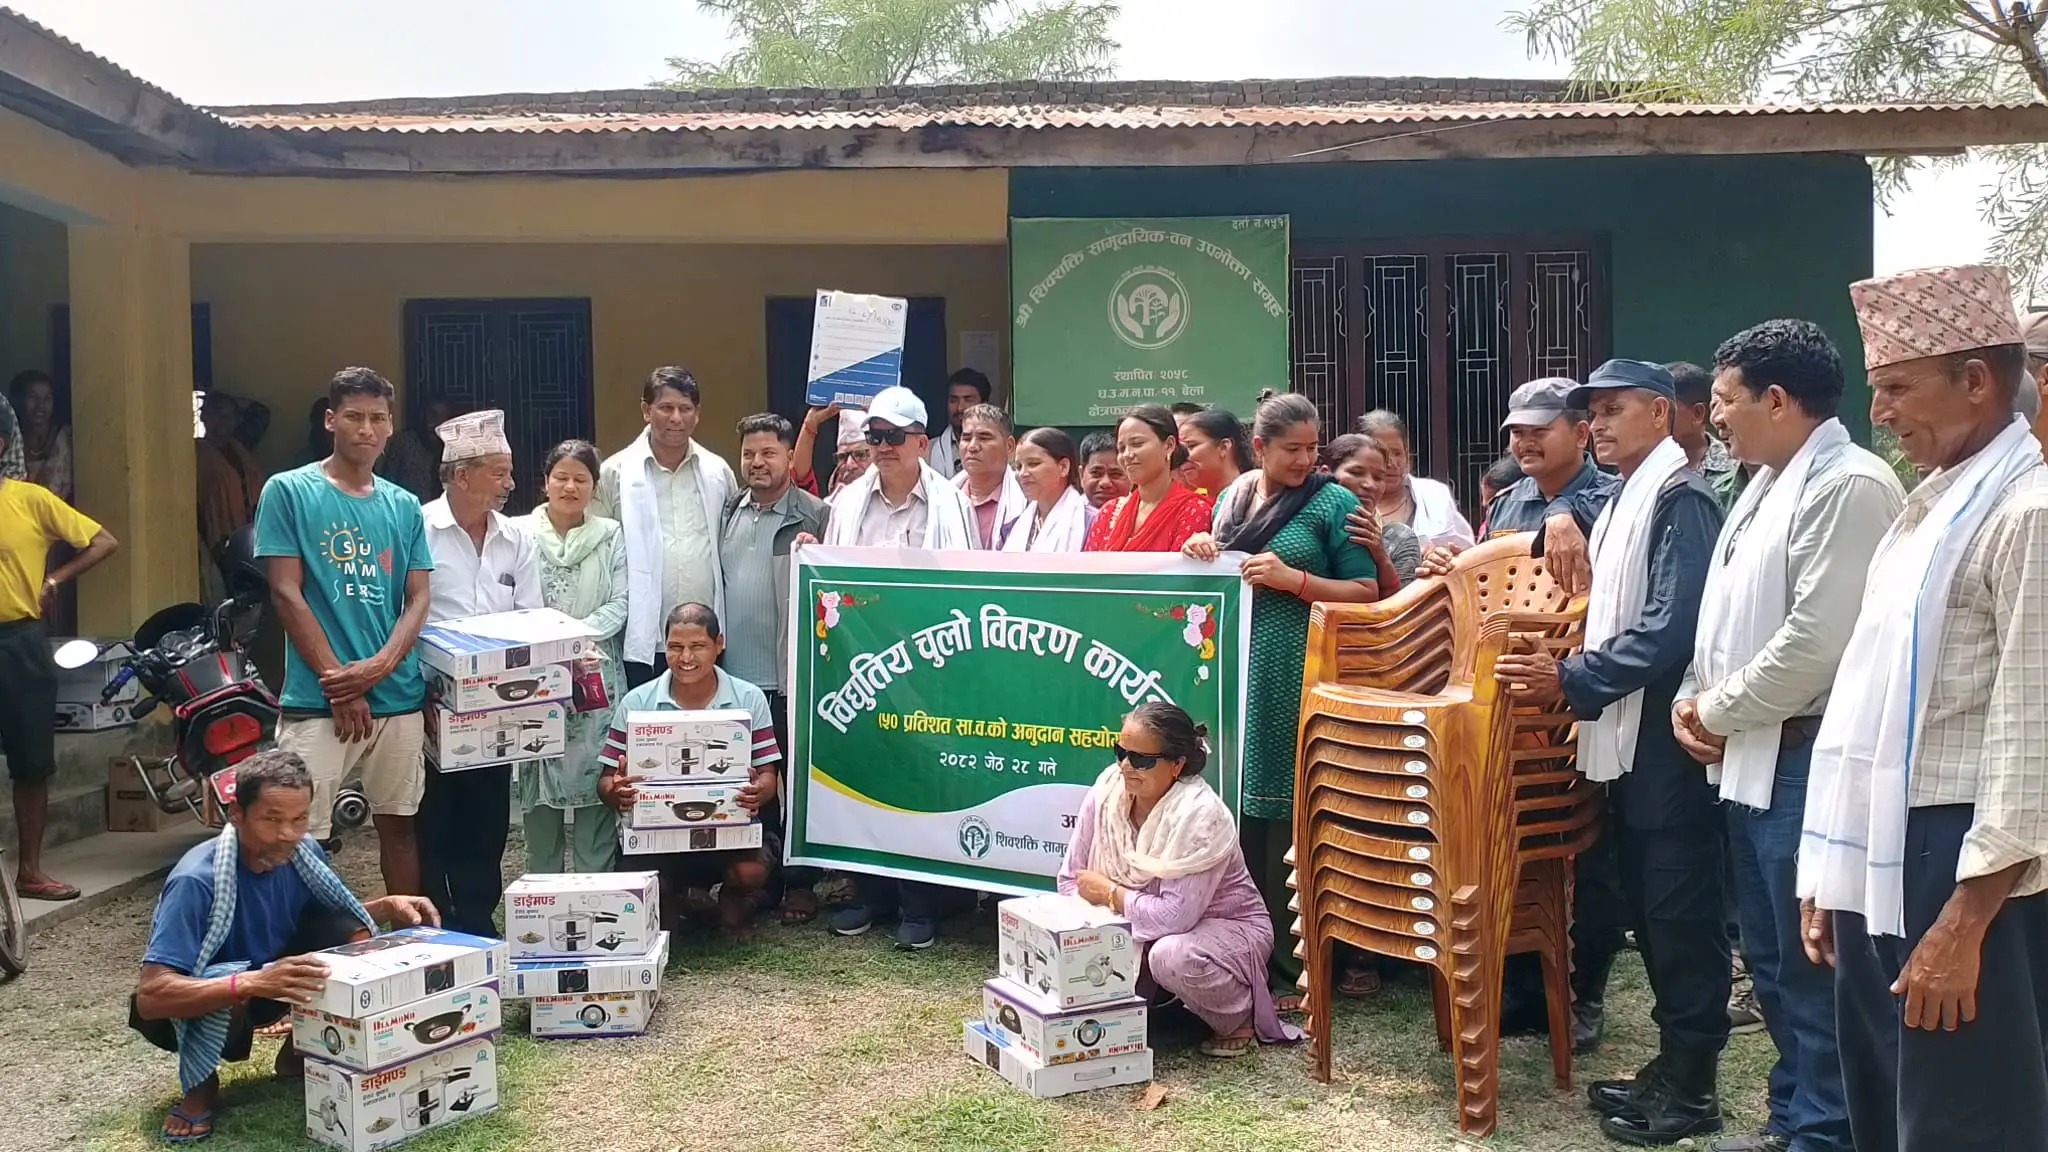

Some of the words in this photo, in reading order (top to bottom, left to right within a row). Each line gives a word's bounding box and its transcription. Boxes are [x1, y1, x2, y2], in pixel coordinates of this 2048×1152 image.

[1015, 303, 1033, 329] श्री
[1028, 252, 1085, 304] शिवशक्ति
[1113, 368, 1153, 382] स्थापित
[911, 608, 972, 669] चुलो
[979, 603, 1083, 663] वितरण
[1083, 638, 1177, 707] कार्य
[903, 709, 953, 734] प्रतिशत
[1011, 722, 1066, 747] अनुदान
[939, 751, 978, 769] २०८२
[984, 750, 1006, 772] जेठ
[1011, 758, 1031, 775] २८
[1038, 756, 1058, 777] गते
[995, 831, 1040, 851] शिवशक्ति
